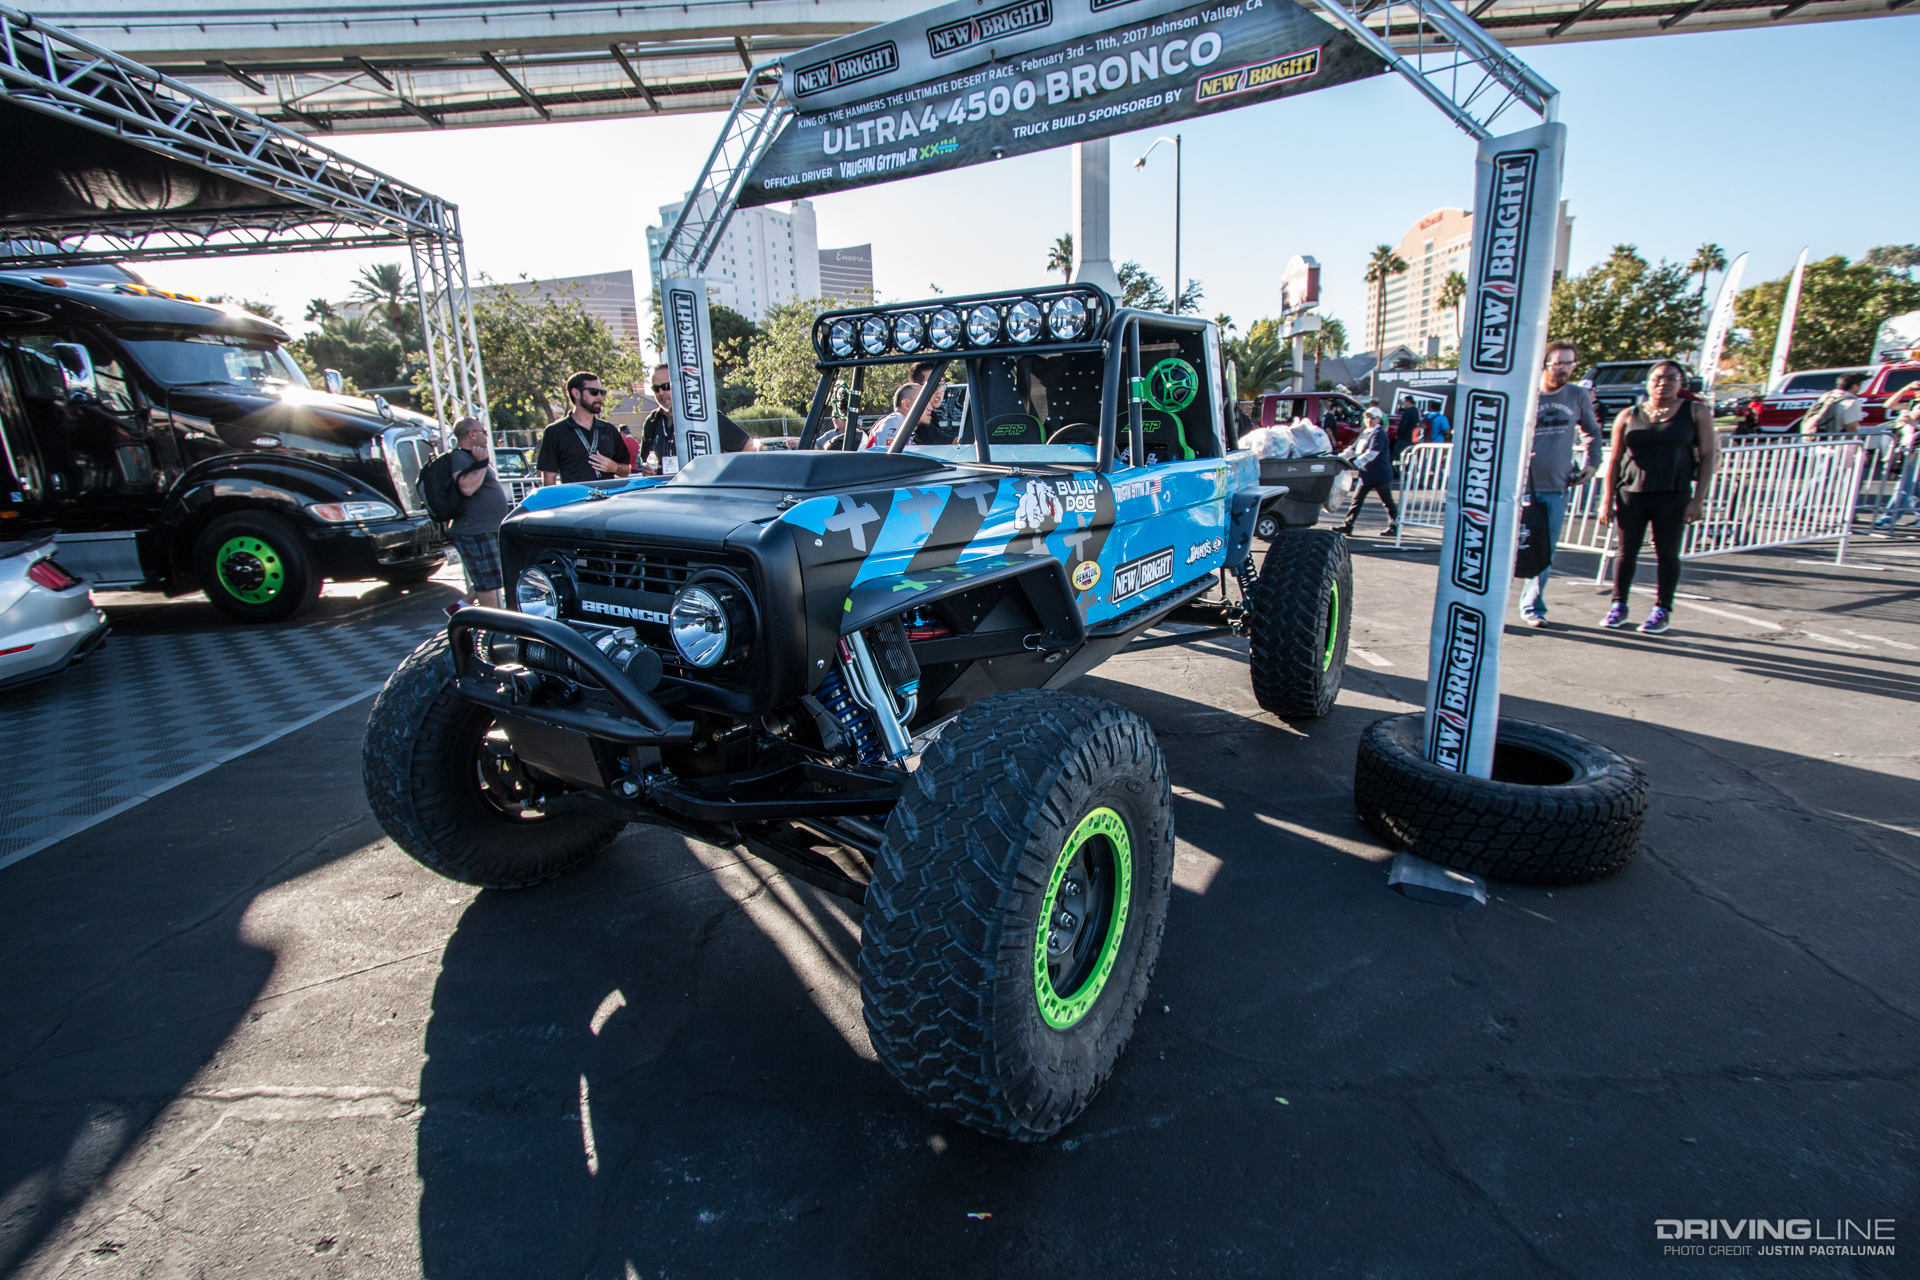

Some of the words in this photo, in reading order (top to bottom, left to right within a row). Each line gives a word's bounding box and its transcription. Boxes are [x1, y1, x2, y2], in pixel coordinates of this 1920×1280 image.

[932, 25, 969, 52] NEW
[980, 1, 1046, 38] BRIGHT
[797, 114, 817, 129] KING
[817, 112, 828, 125] OF
[828, 109, 845, 123] THE
[845, 100, 886, 120] HAMMERS
[886, 94, 904, 108] THE
[904, 82, 950, 104] ULTIMATE
[951, 71, 987, 92] DESERT
[988, 65, 1015, 81] RACE
[1021, 51, 1064, 73] February
[1066, 44, 1084, 60] 3rd
[1095, 35, 1120, 52] 11th,
[1122, 27, 1148, 45] 2017
[1150, 15, 1198, 37] Johnson
[1201, 4, 1243, 24] Valley,
[1245, 0, 1263, 11] CA
[797, 68, 832, 92] NEW
[837, 47, 895, 84] BRIGHT
[822, 105, 940, 155] ULTRA4
[947, 79, 1036, 125] 4500
[1046, 31, 1222, 105] BRONCO
[1012, 120, 1049, 139] TRUCK
[1051, 112, 1086, 131] BUILD
[1088, 94, 1162, 122] SPONSORED
[1164, 88, 1183, 104] BY
[1201, 73, 1239, 97] NEW
[1249, 53, 1316, 86] BRIGHT
[764, 174, 800, 190] OFFICIAL
[801, 167, 833, 184] DRIVER
[839, 155, 876, 179] VAUGHN
[906, 147, 918, 163] JR
[1489, 159, 1528, 277] BRIGHT
[835, 249, 870, 262] Encore
[675, 295, 697, 365] BRIGHT
[1479, 296, 1509, 363] NEW
[684, 375, 702, 416] NEW
[1465, 400, 1497, 507] BRIGHT
[1055, 479, 1098, 495] BULLY
[1066, 494, 1095, 511] DOG
[1076, 567, 1097, 584] PENNZOIL
[1115, 568, 1138, 598] NEW
[1141, 555, 1172, 586] BRIGHT
[1461, 519, 1485, 584] NEW
[581, 600, 670, 625] BRONCO
[1442, 616, 1479, 715] BRIGHT
